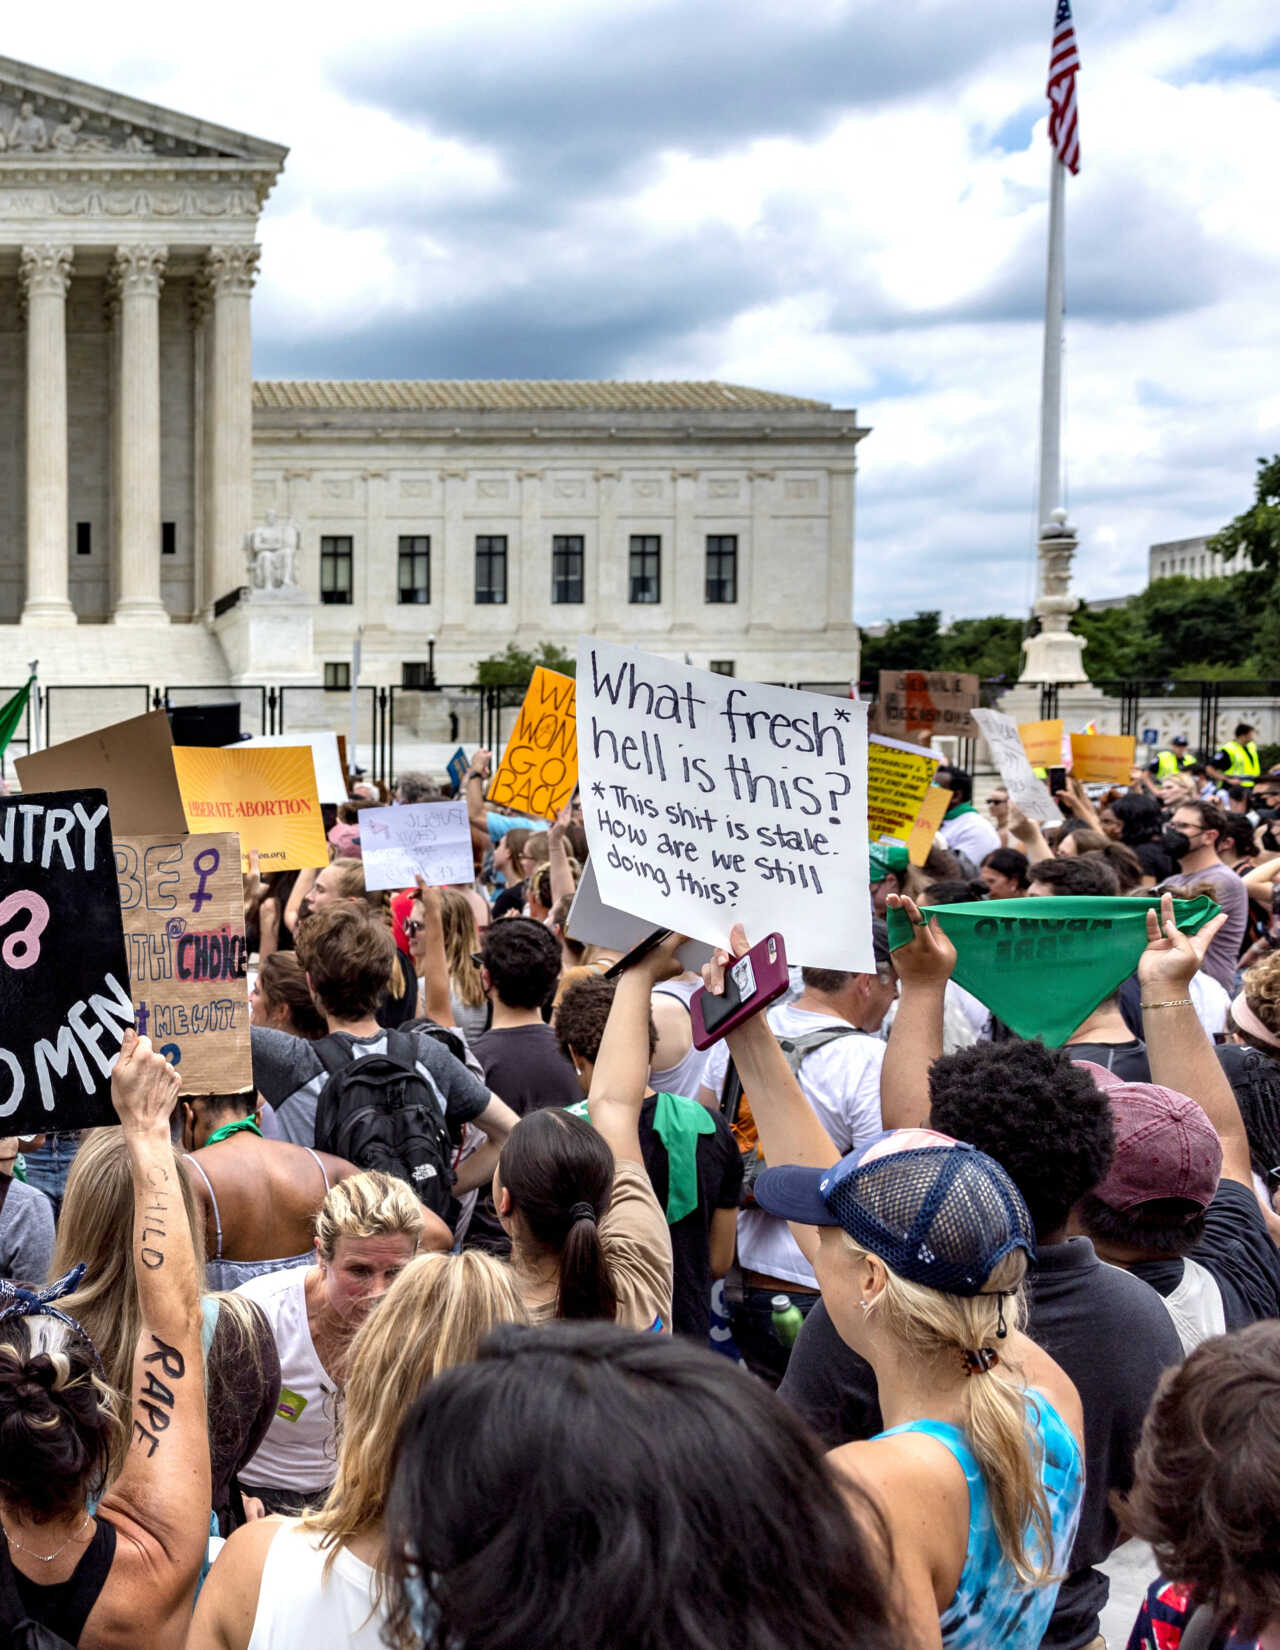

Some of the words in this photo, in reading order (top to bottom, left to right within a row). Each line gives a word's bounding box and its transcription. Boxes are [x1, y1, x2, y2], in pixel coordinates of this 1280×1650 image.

[592, 650, 706, 728] What
[492, 768, 570, 821] BACK
[509, 745, 566, 787] GO
[592, 716, 666, 781] hell
[678, 744, 716, 792] is
[724, 754, 851, 824] this?
[189, 801, 234, 818] LIBERATE
[235, 799, 312, 817] ABORTION
[597, 808, 647, 846] How
[657, 833, 699, 862] are
[712, 850, 746, 872] we
[666, 802, 718, 832] shit
[726, 815, 749, 840] is
[607, 844, 670, 897] doing
[676, 868, 740, 907] this?
[33, 972, 136, 1112] MEN
[140, 1165, 170, 1272] CHILD
[134, 1334, 186, 1459] RAPE
